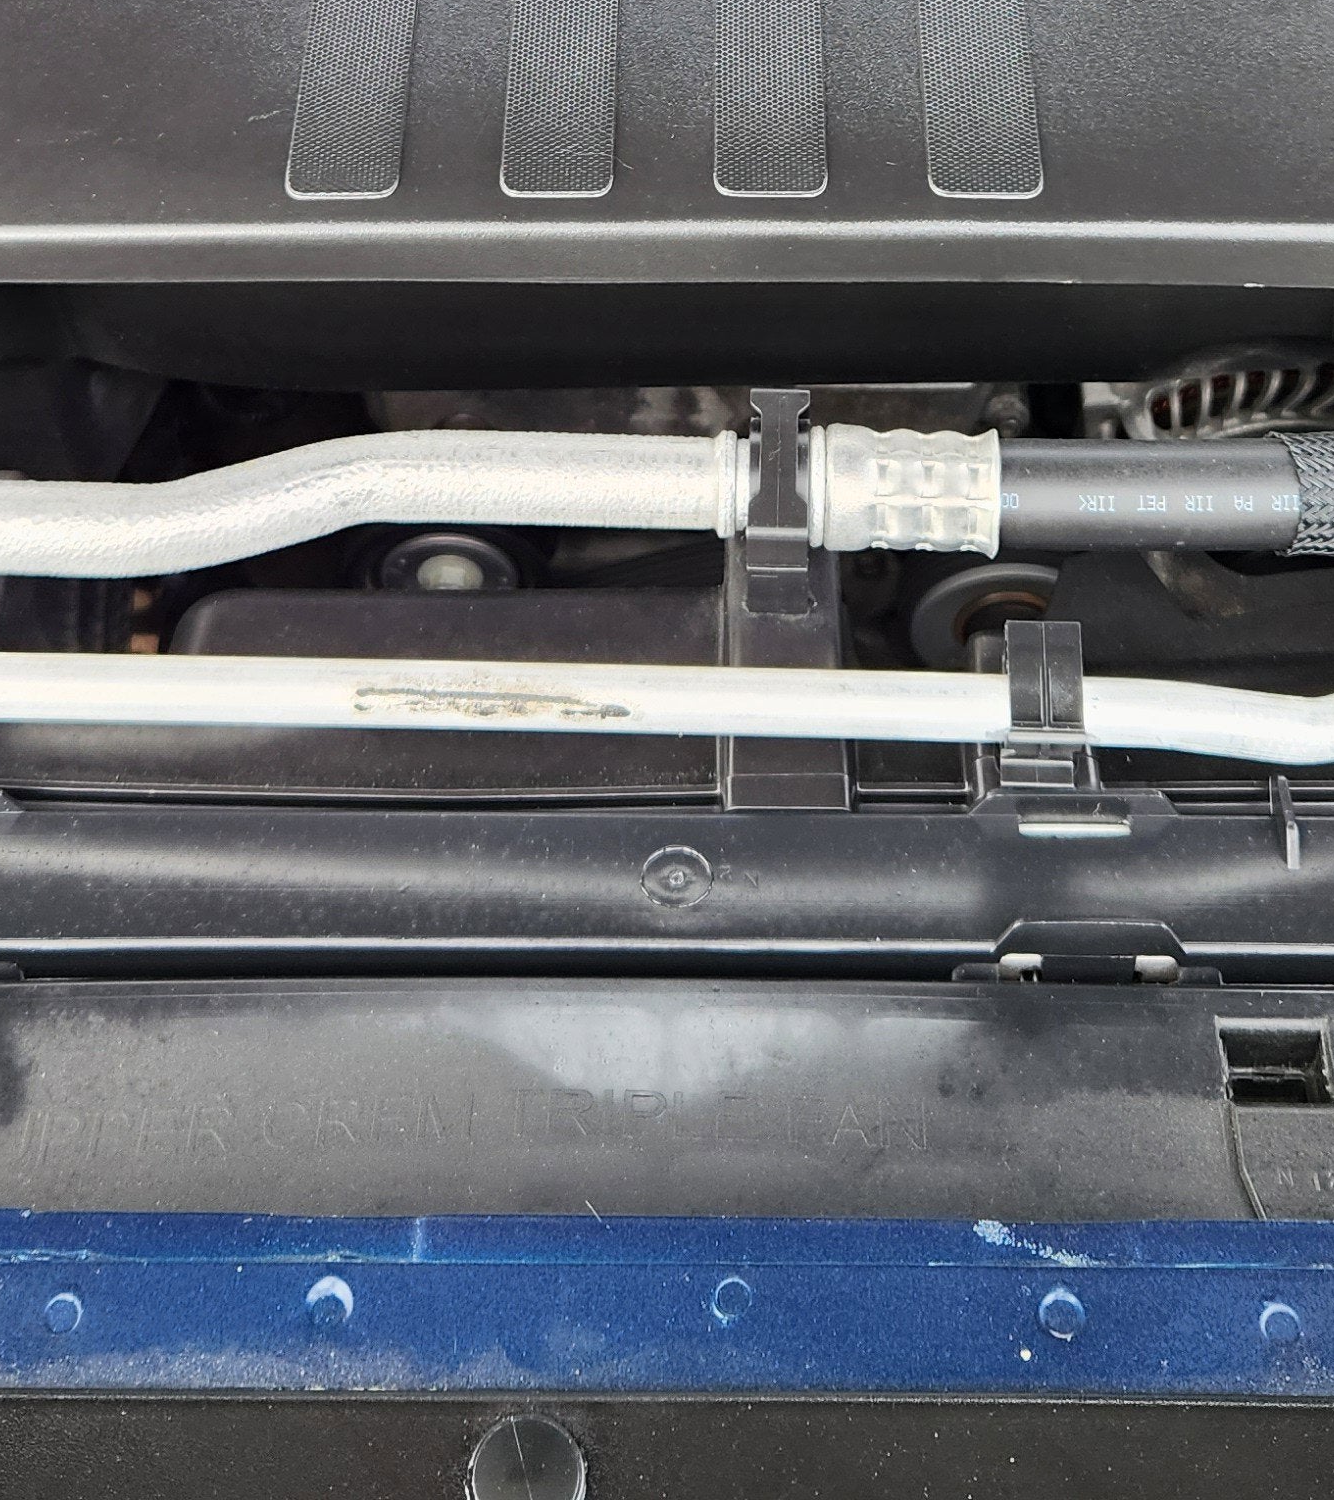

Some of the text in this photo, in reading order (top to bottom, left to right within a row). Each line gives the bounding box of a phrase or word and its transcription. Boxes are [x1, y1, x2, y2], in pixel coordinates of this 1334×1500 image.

[1136, 494, 1166, 511] PET
[1233, 494, 1254, 511] PA
[511, 1088, 752, 1143] TRIPLE
[785, 1096, 930, 1152] FAN
